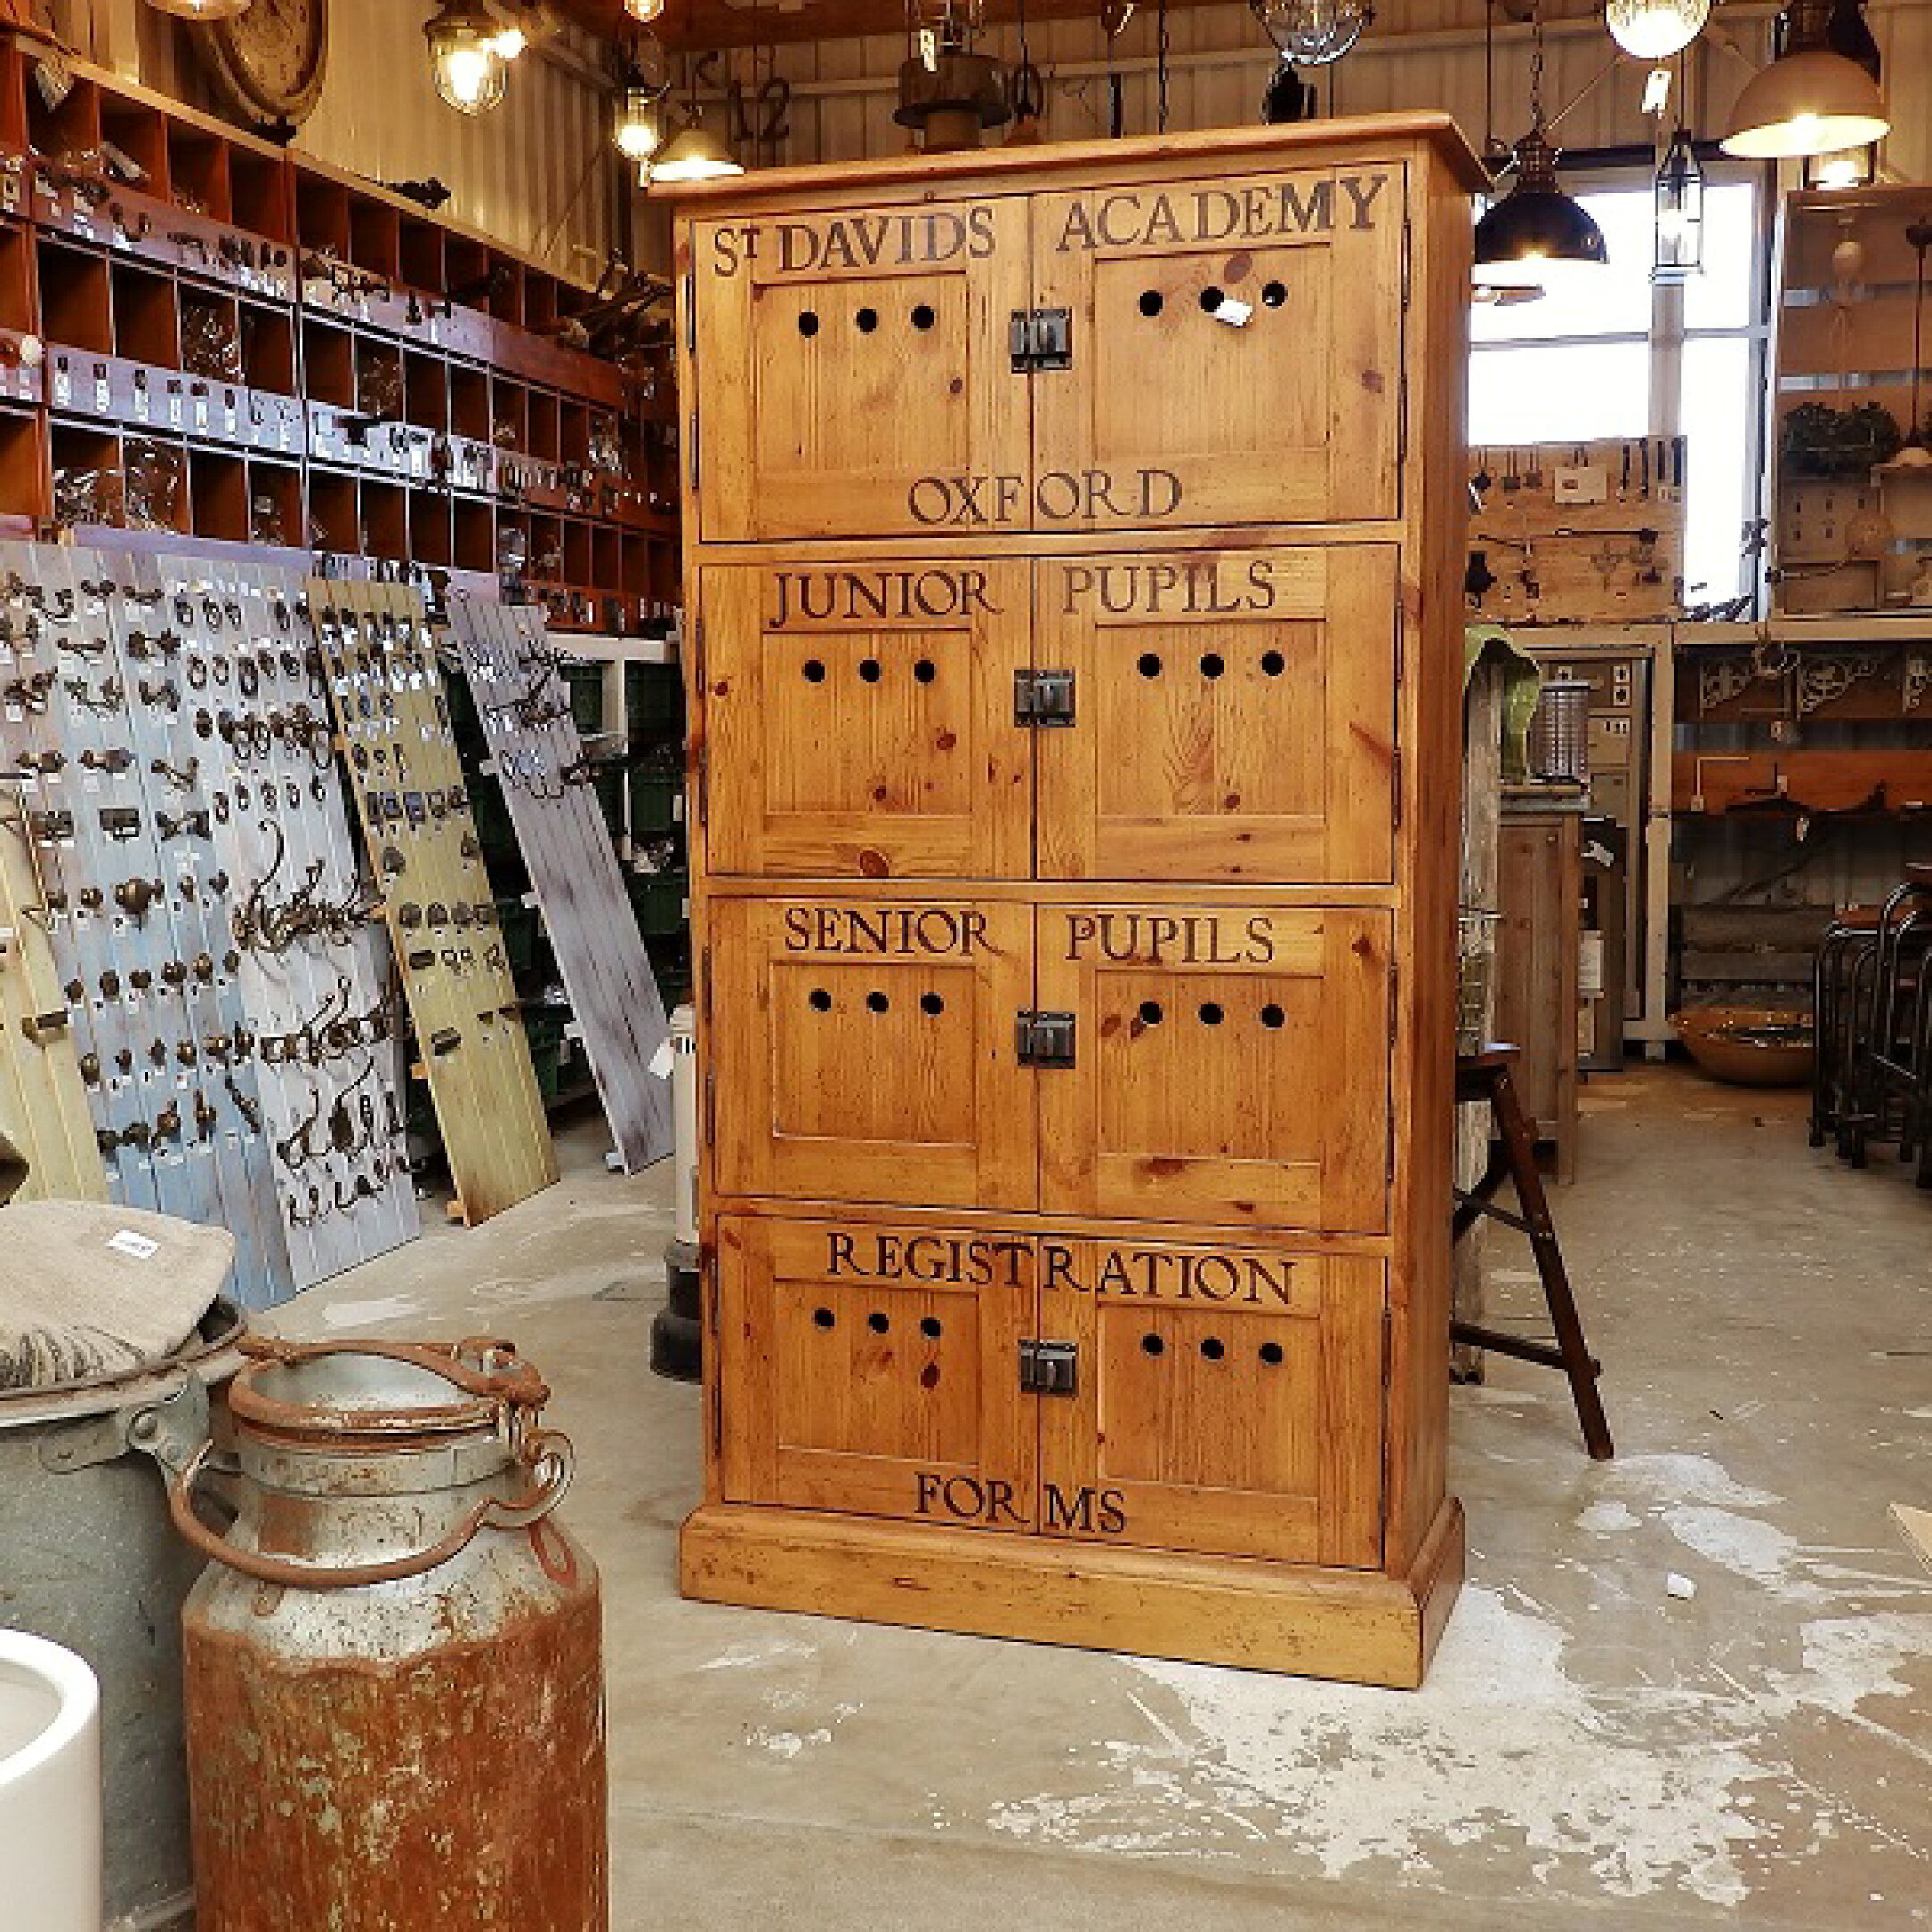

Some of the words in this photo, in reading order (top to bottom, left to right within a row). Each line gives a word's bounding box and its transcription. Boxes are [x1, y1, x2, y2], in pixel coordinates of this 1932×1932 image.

[775, 204, 996, 274] DAVIDS
[1055, 173, 1389, 252] ACADEMY
[907, 469, 1182, 526] OXFORD
[768, 569, 1005, 629] JUNIOR
[1062, 559, 1275, 614] PUPILS
[784, 907, 1005, 957] SENIOR
[1064, 913, 1275, 966] PUPILS
[826, 1232, 1298, 1305] REGISTRATION
[913, 1470, 1128, 1534] FORMS
